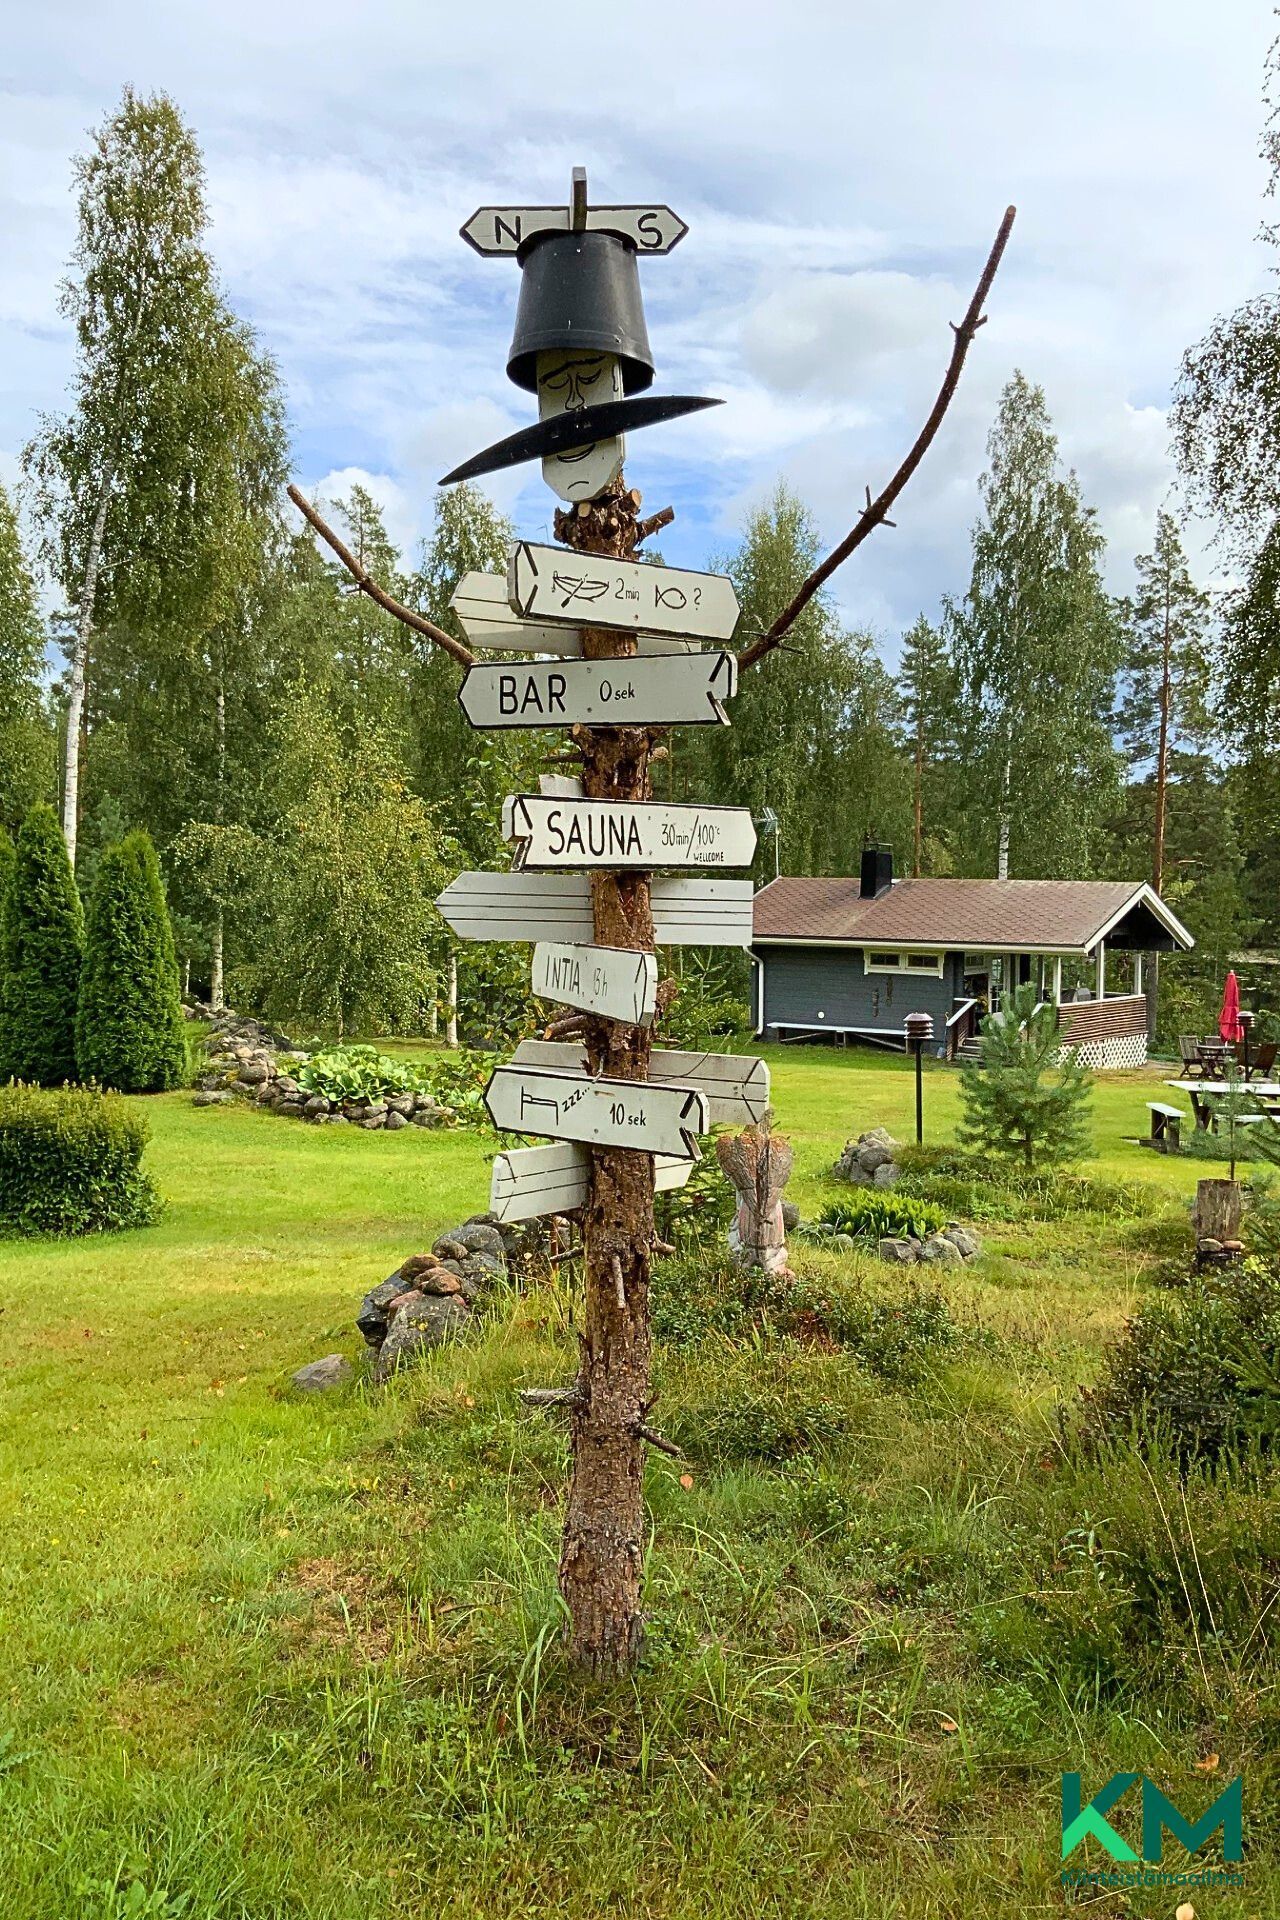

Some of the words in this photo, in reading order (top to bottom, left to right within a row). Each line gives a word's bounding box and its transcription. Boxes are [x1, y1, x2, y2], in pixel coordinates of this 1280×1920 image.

[494, 215, 521, 244] N
[637, 213, 663, 249] S
[499, 674, 566, 715] BAR
[546, 810, 643, 856] SAUNA
